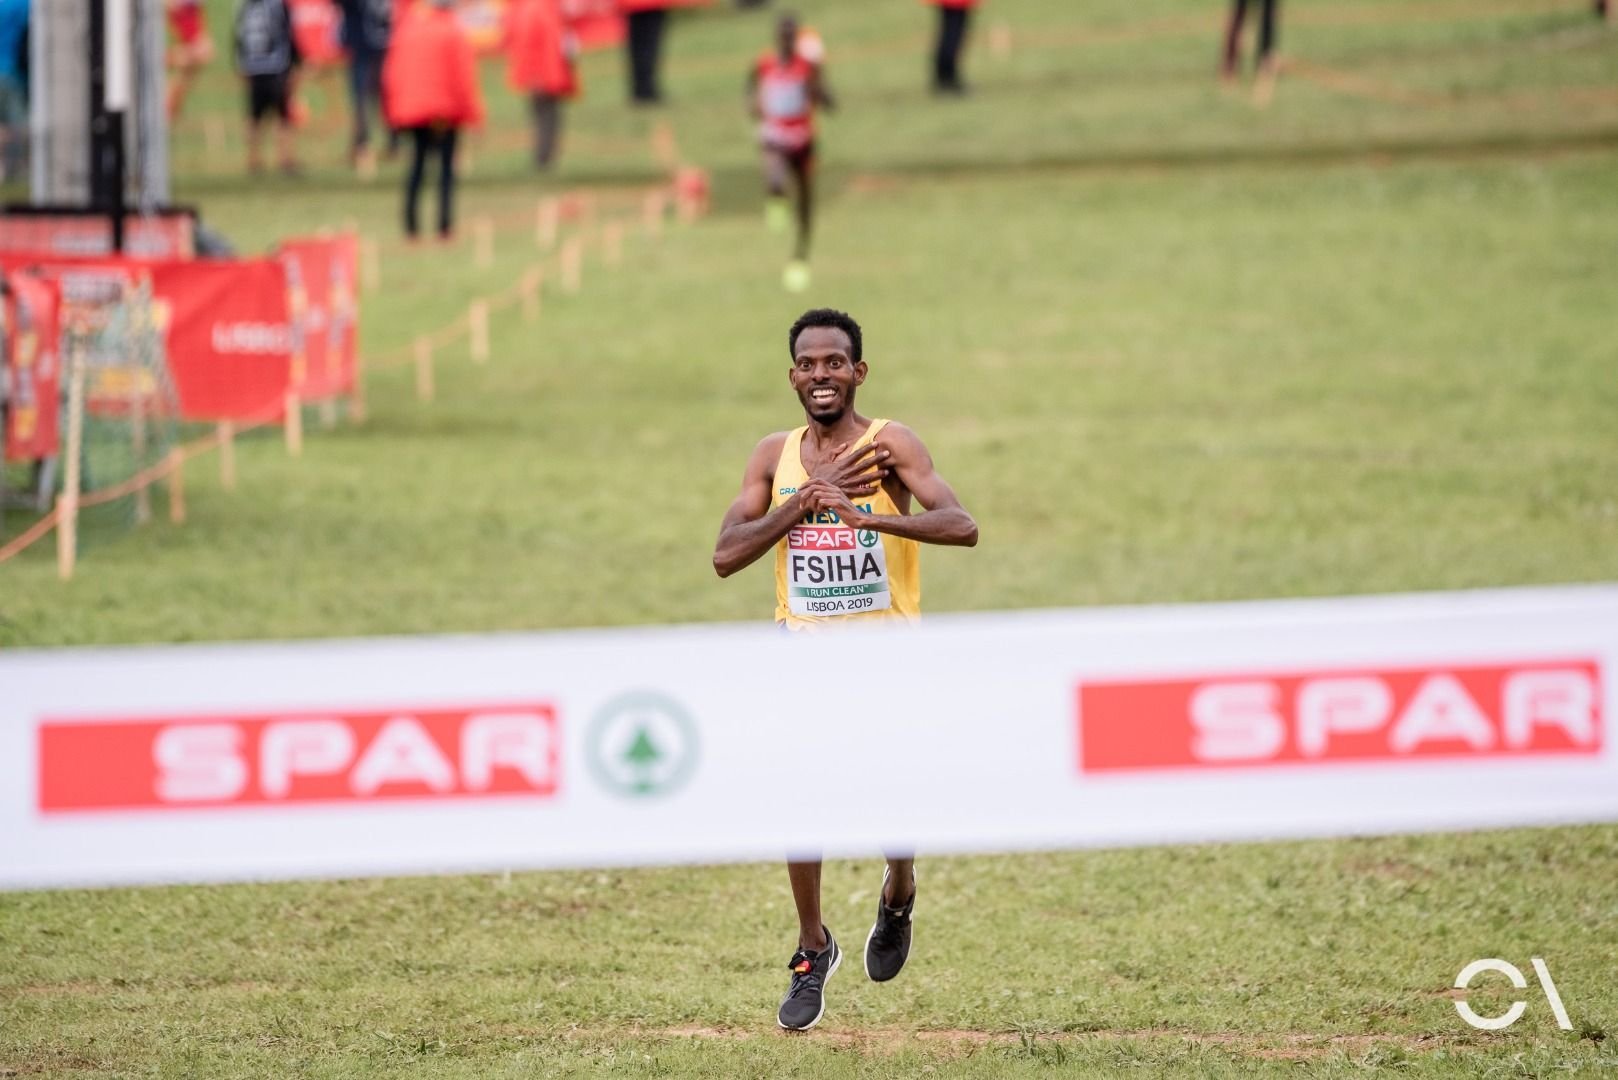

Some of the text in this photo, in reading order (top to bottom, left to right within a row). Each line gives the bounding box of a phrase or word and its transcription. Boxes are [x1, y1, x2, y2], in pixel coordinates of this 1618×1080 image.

[789, 529, 854, 547] SPAR
[792, 552, 882, 584] FSIHA
[806, 597, 873, 612] LISBOA 2019
[810, 588, 830, 597] RUN
[1189, 667, 1598, 760] SPAR
[152, 711, 558, 803] SPAR
